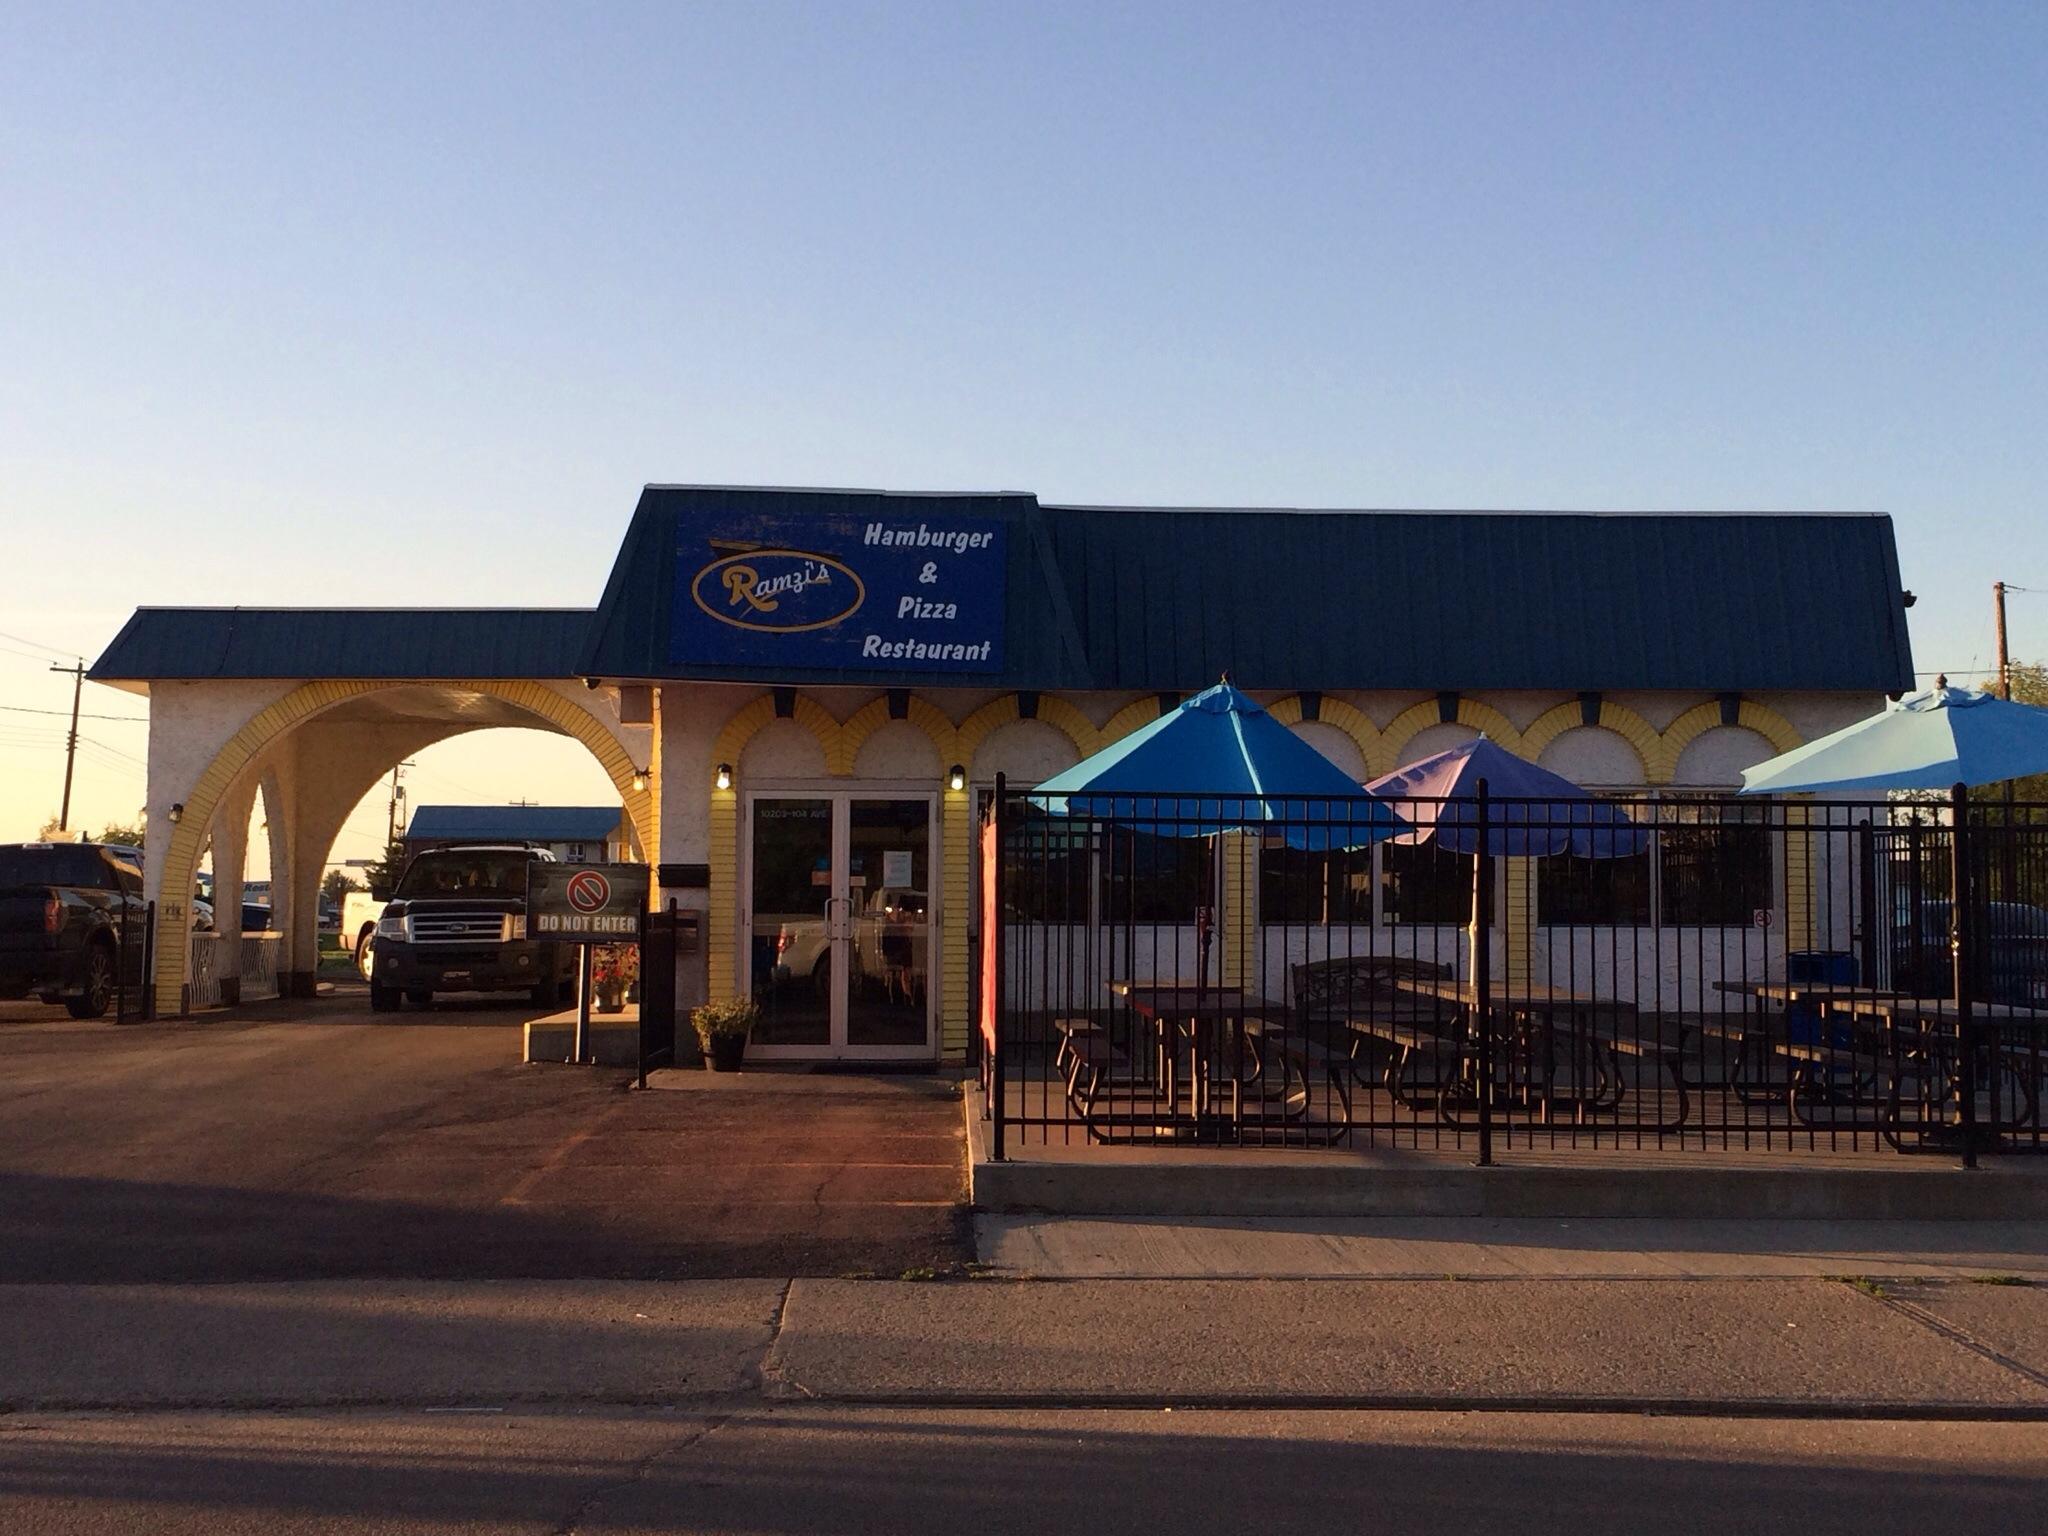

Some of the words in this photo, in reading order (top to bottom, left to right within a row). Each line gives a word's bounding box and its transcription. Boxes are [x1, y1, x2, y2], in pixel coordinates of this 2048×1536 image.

[864, 522, 993, 554] Hamburger
[918, 561, 938, 584] &
[722, 561, 830, 612] Ramzi's
[897, 596, 957, 619] Pizza
[862, 634, 991, 661] Restaurant
[538, 915, 559, 931] DO
[561, 915, 590, 932] NOT
[592, 916, 637, 932] ENTER
